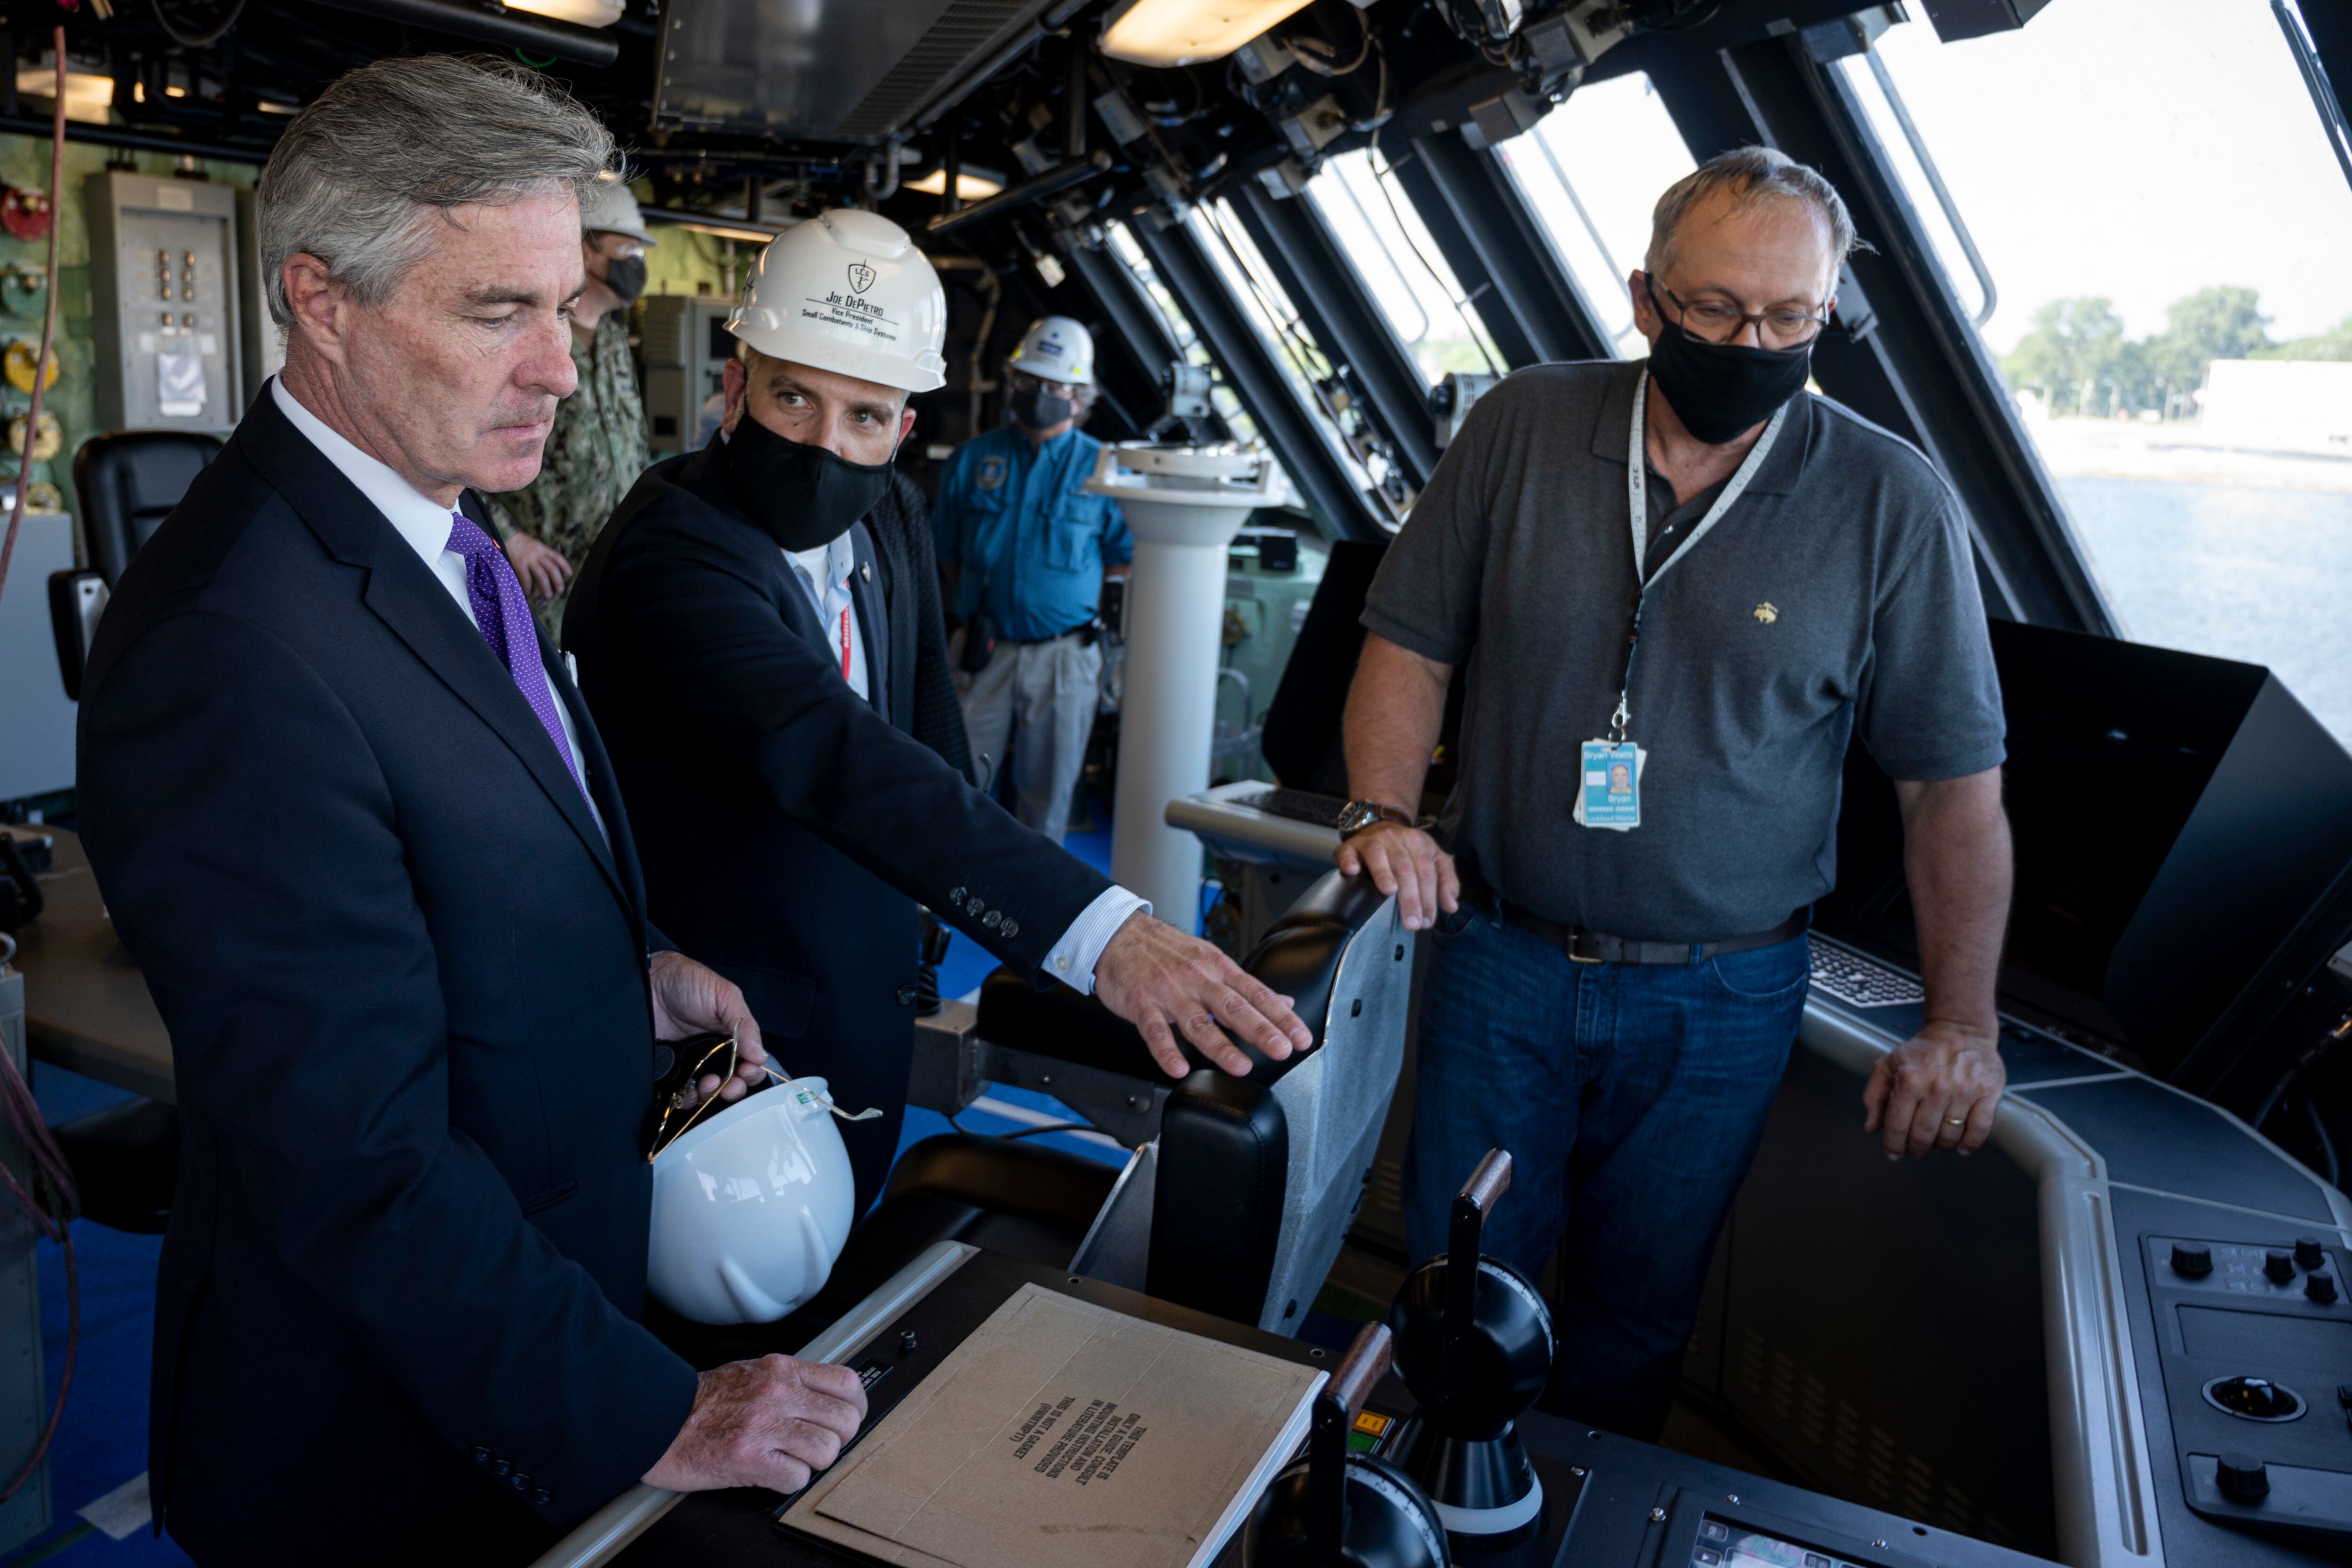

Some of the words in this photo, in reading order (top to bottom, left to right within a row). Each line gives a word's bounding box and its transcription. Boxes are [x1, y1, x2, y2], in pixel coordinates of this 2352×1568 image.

[855, 268, 870, 277] LCS
[802, 309, 818, 319] Small
[819, 313, 853, 328] Combatants
[860, 324, 873, 334] Ship
[874, 328, 897, 341] Systems
[832, 307, 844, 317] Vice
[845, 311, 873, 325] President
[1584, 752, 1607, 760] Bryan
[1057, 1396, 1076, 1411] THIS
[1092, 1399, 1104, 1408] IN
[1041, 1417, 1057, 1431] NOT
[1061, 1406, 1098, 1442] LITERATURE
[1084, 1402, 1118, 1434] MOUNTING
[1122, 1413, 1141, 1430] ONLY
[1082, 1415, 1123, 1457] INSTALLATION
[1128, 1426, 1147, 1441] THIS
[1012, 1435, 1041, 1460] GASKET
[1046, 1433, 1091, 1479] INSTRUCTIONS
[1034, 1441, 1069, 1473] PROVIDED
[1070, 1456, 1088, 1471] AND
[1103, 1441, 1136, 1473] TEMPLATE
[1075, 1456, 1105, 1486] CONSULT
[1097, 1472, 1110, 1480] IS
